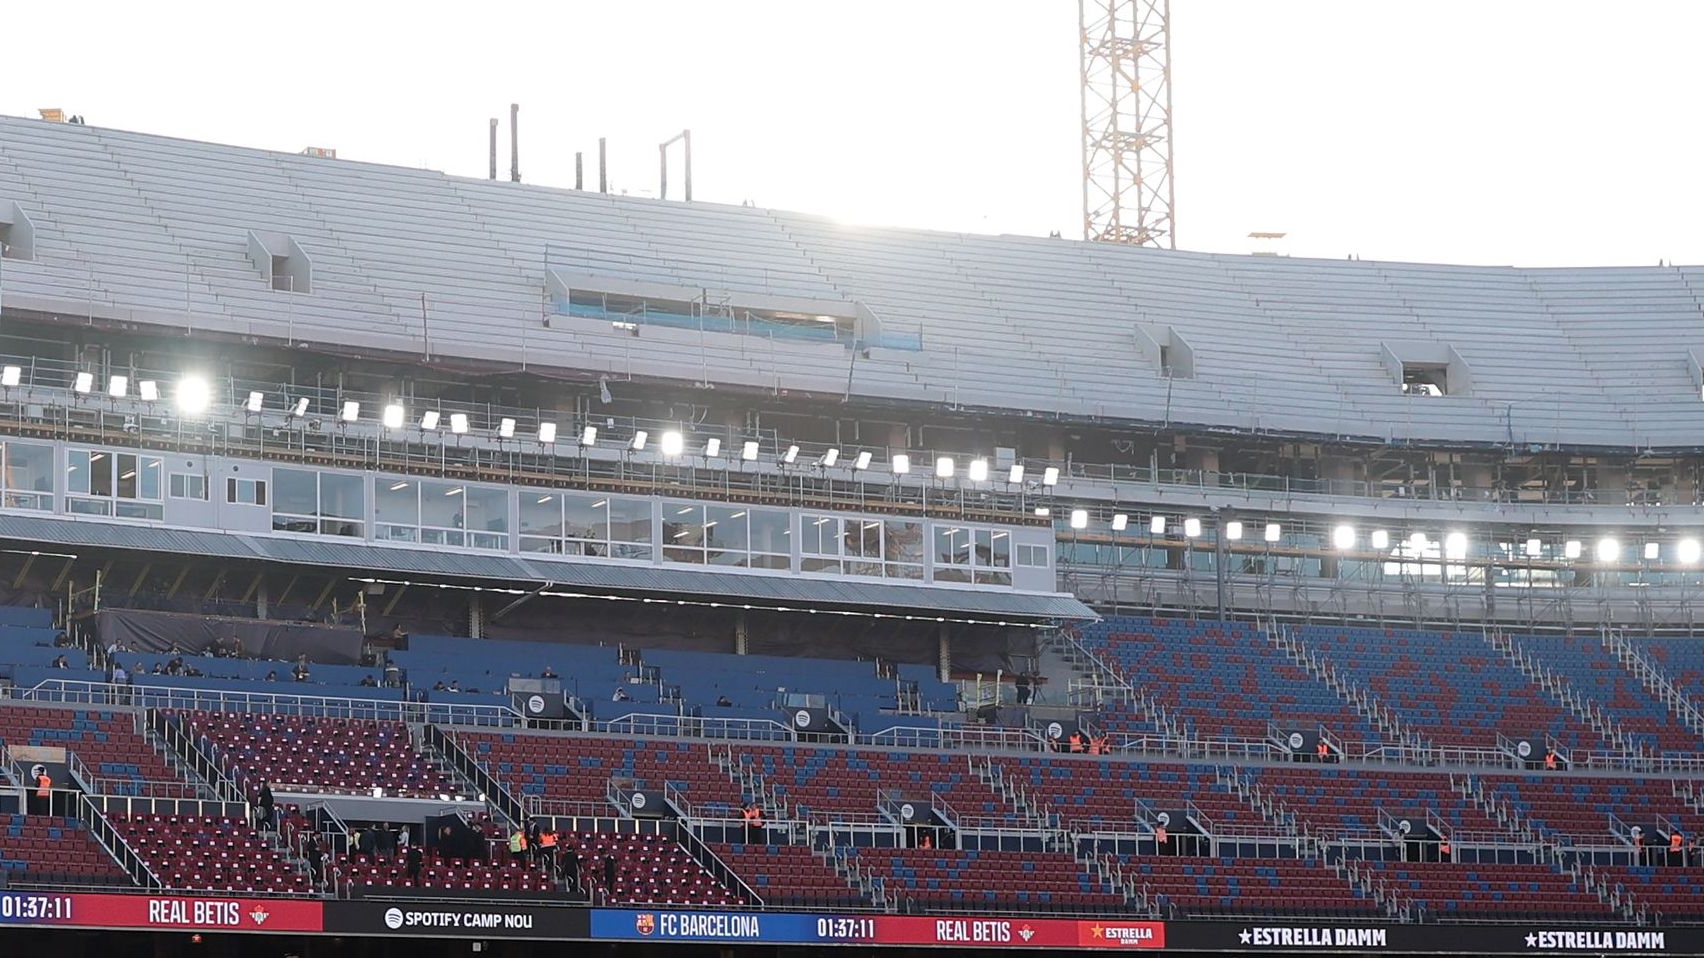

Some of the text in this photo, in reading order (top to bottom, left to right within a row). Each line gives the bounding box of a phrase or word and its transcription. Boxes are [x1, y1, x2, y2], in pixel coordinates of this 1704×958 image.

[2, 895, 71, 919] 01:37:11
[149, 899, 240, 925] REAL BETIS
[405, 911, 533, 929] SPOTIFY CAMP NOU
[660, 913, 760, 937] FC BARCELONA
[817, 918, 874, 938] 01:37:11
[936, 920, 1011, 942] REAL BETIS
[1105, 927, 1153, 939] ESTRELLA
[1252, 927, 1387, 947] ESTRELLA DAMM
[1538, 931, 1665, 949] ESTRELLA DAMM
